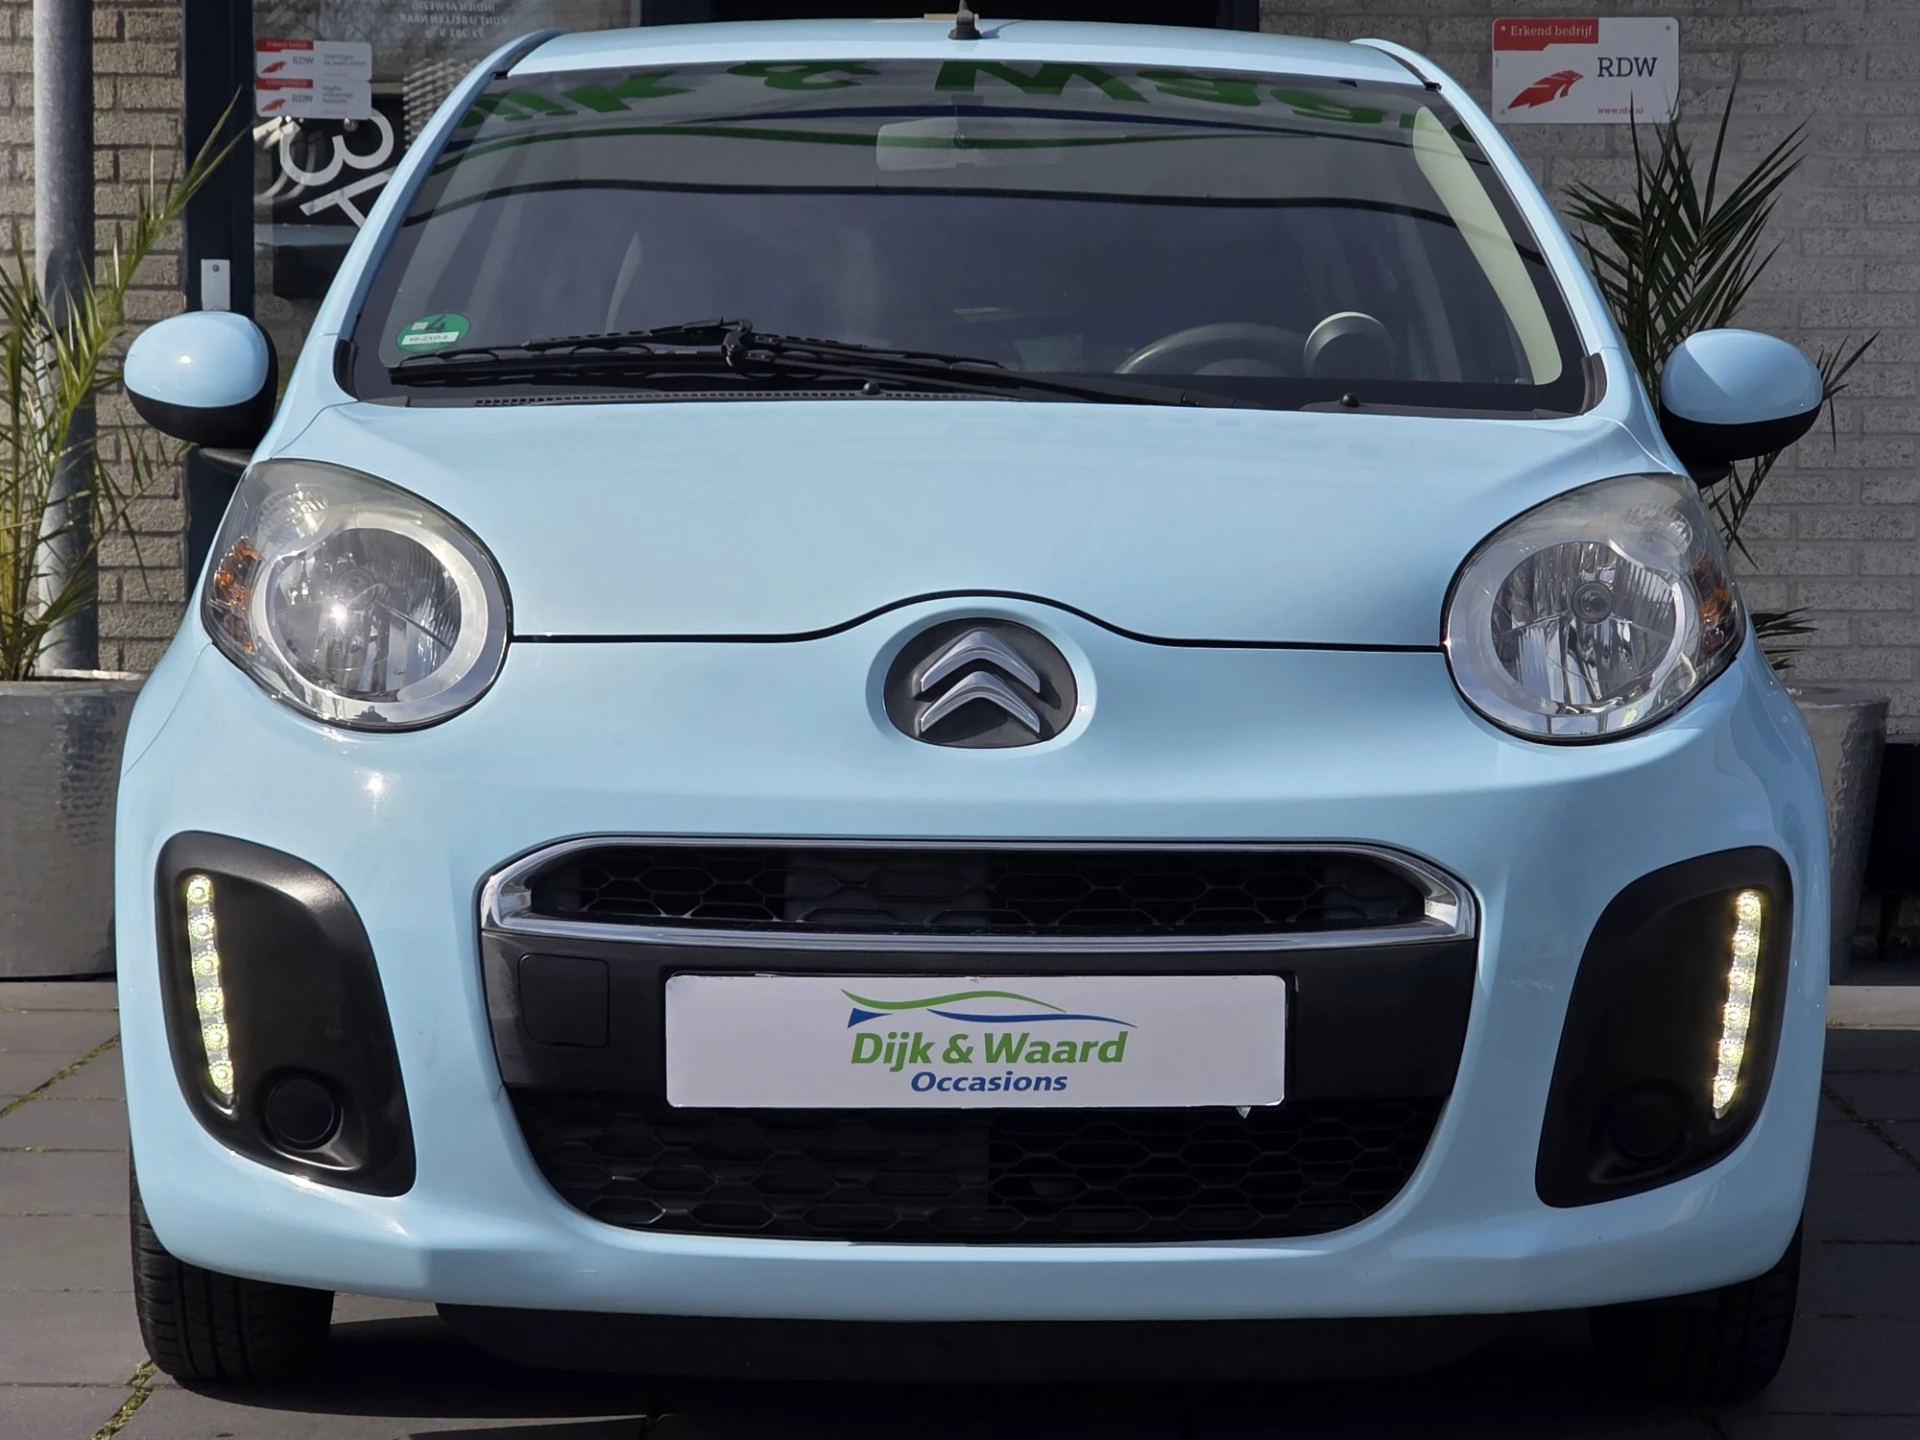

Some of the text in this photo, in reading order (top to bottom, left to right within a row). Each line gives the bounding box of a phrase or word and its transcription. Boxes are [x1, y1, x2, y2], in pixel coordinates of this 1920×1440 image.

[1510, 24, 1593, 39] Erkend bedrijf
[1597, 56, 1658, 78] RDW
[851, 1030, 1128, 1073] Dijk & Waard
[910, 1071, 1068, 1093] Occasions
